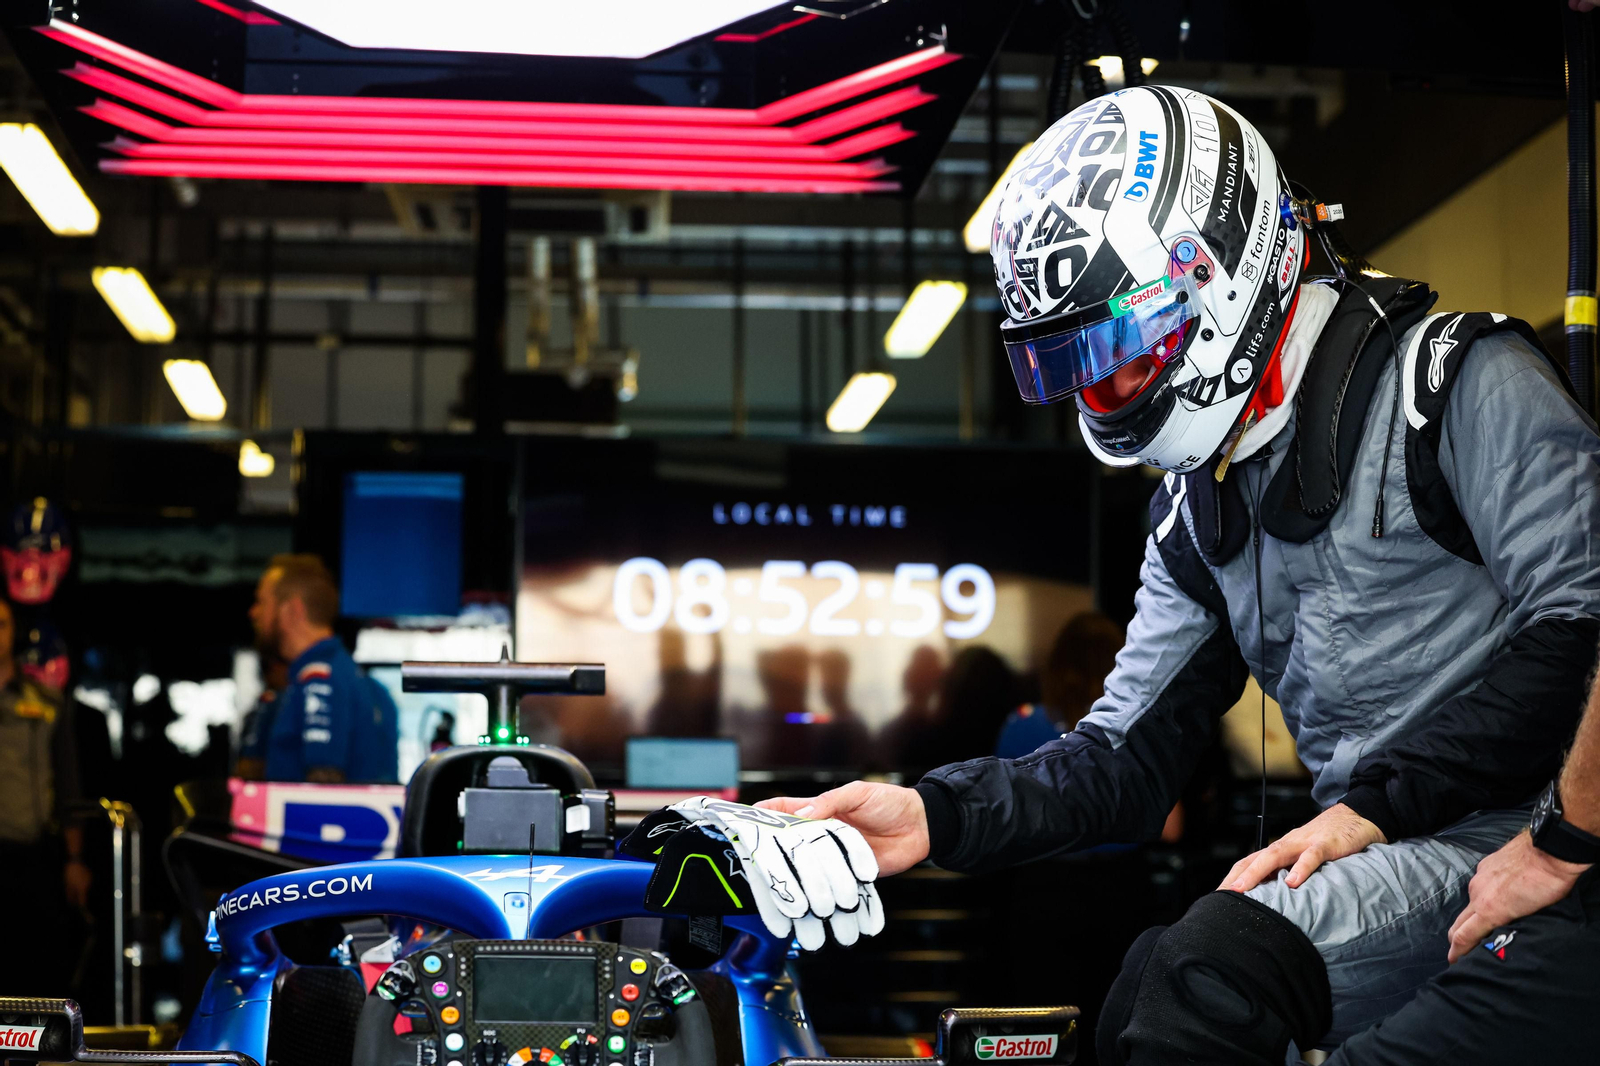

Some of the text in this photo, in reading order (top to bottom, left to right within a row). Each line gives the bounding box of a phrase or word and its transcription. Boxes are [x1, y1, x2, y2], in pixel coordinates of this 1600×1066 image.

[1134, 131, 1159, 180] BWT
[1217, 142, 1238, 222] MANDIANT
[1251, 200, 1271, 260] fantom
[1281, 246, 1296, 284] BELL
[1130, 283, 1164, 306] Castrol
[1245, 302, 1275, 358] lif3.com
[713, 502, 908, 527] LOCAL TIME
[612, 556, 997, 640] 08:52:59
[995, 1037, 1052, 1058] Castrol
